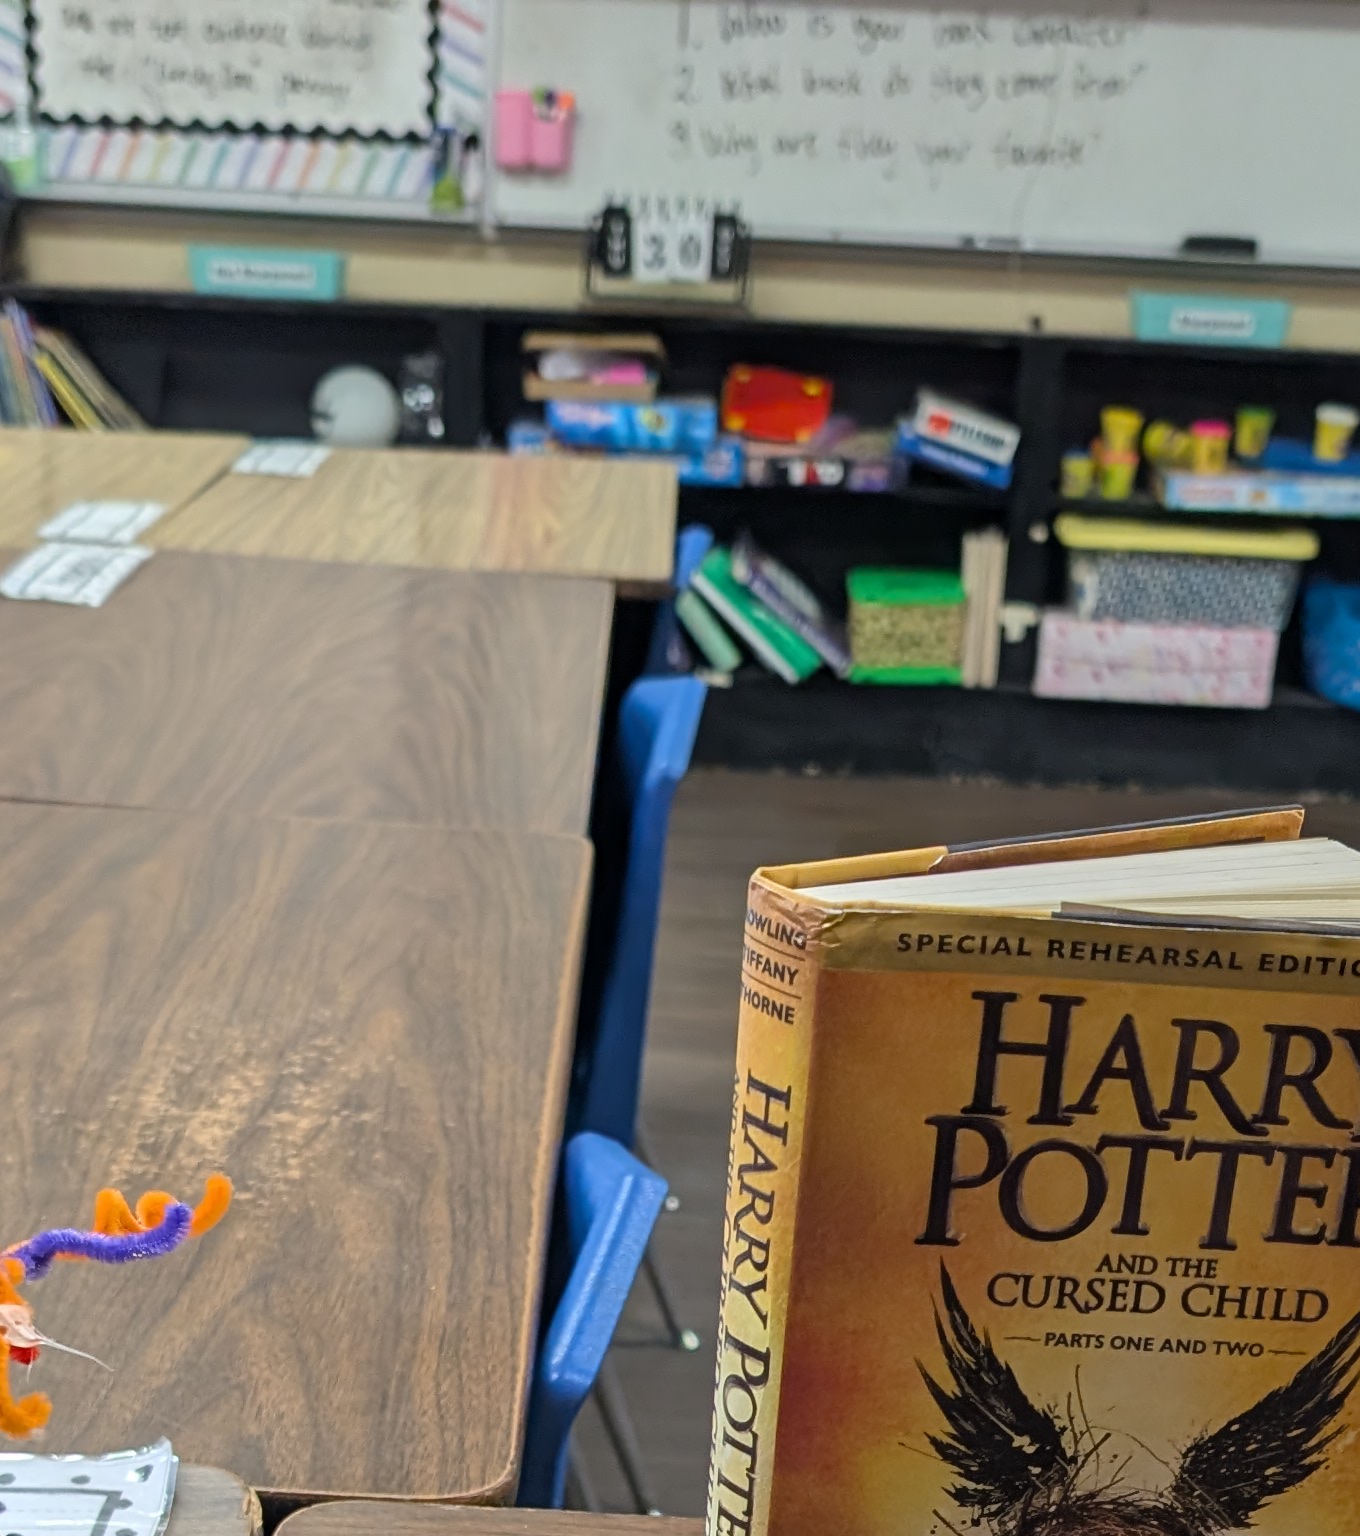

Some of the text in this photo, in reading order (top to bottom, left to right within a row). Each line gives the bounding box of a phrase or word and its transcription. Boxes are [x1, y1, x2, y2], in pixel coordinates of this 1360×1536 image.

[896, 932, 1033, 957] SPECIAL
[1046, 938, 1244, 971] REHEARSAL
[728, 1067, 792, 1331] HARRY
[1095, 1253, 1219, 1280] AND THE
[986, 1271, 1331, 1323] CURSED CHILD
[1043, 1331, 1265, 1358] PARTS ONE AND TWO
